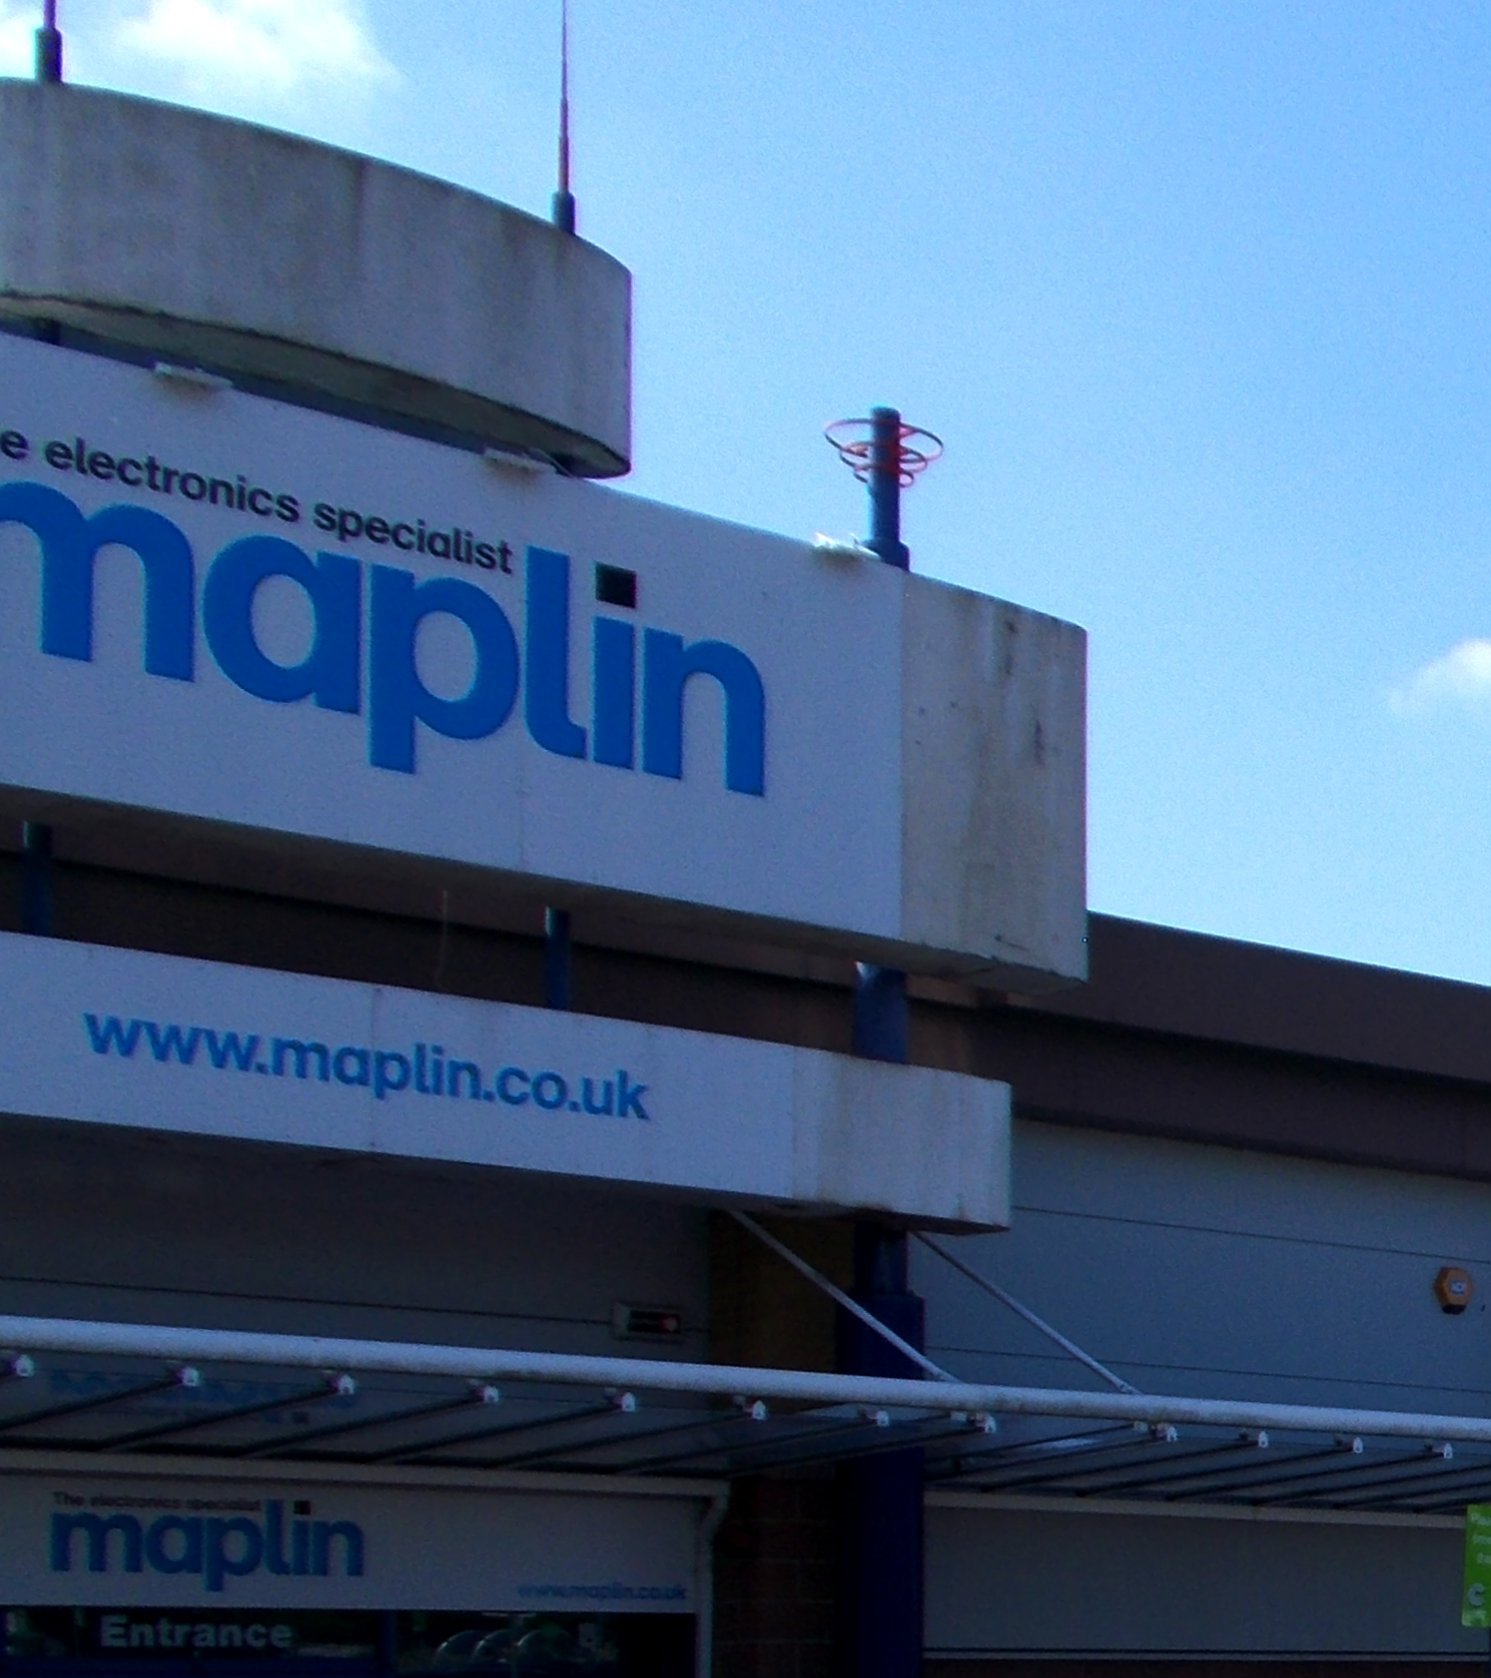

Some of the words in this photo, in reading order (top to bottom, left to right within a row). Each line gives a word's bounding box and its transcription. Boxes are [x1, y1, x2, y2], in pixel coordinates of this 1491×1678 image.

[45, 436, 301, 524] electronics
[313, 501, 513, 575] specialist
[0, 481, 766, 797] maplin
[83, 1011, 649, 1121] www.maplin.co.uk
[53, 1491, 84, 1506] The
[50, 1499, 364, 1592] maplin
[517, 1581, 686, 1601] www.maplin.co.uk
[102, 1615, 293, 1649] Entrance
